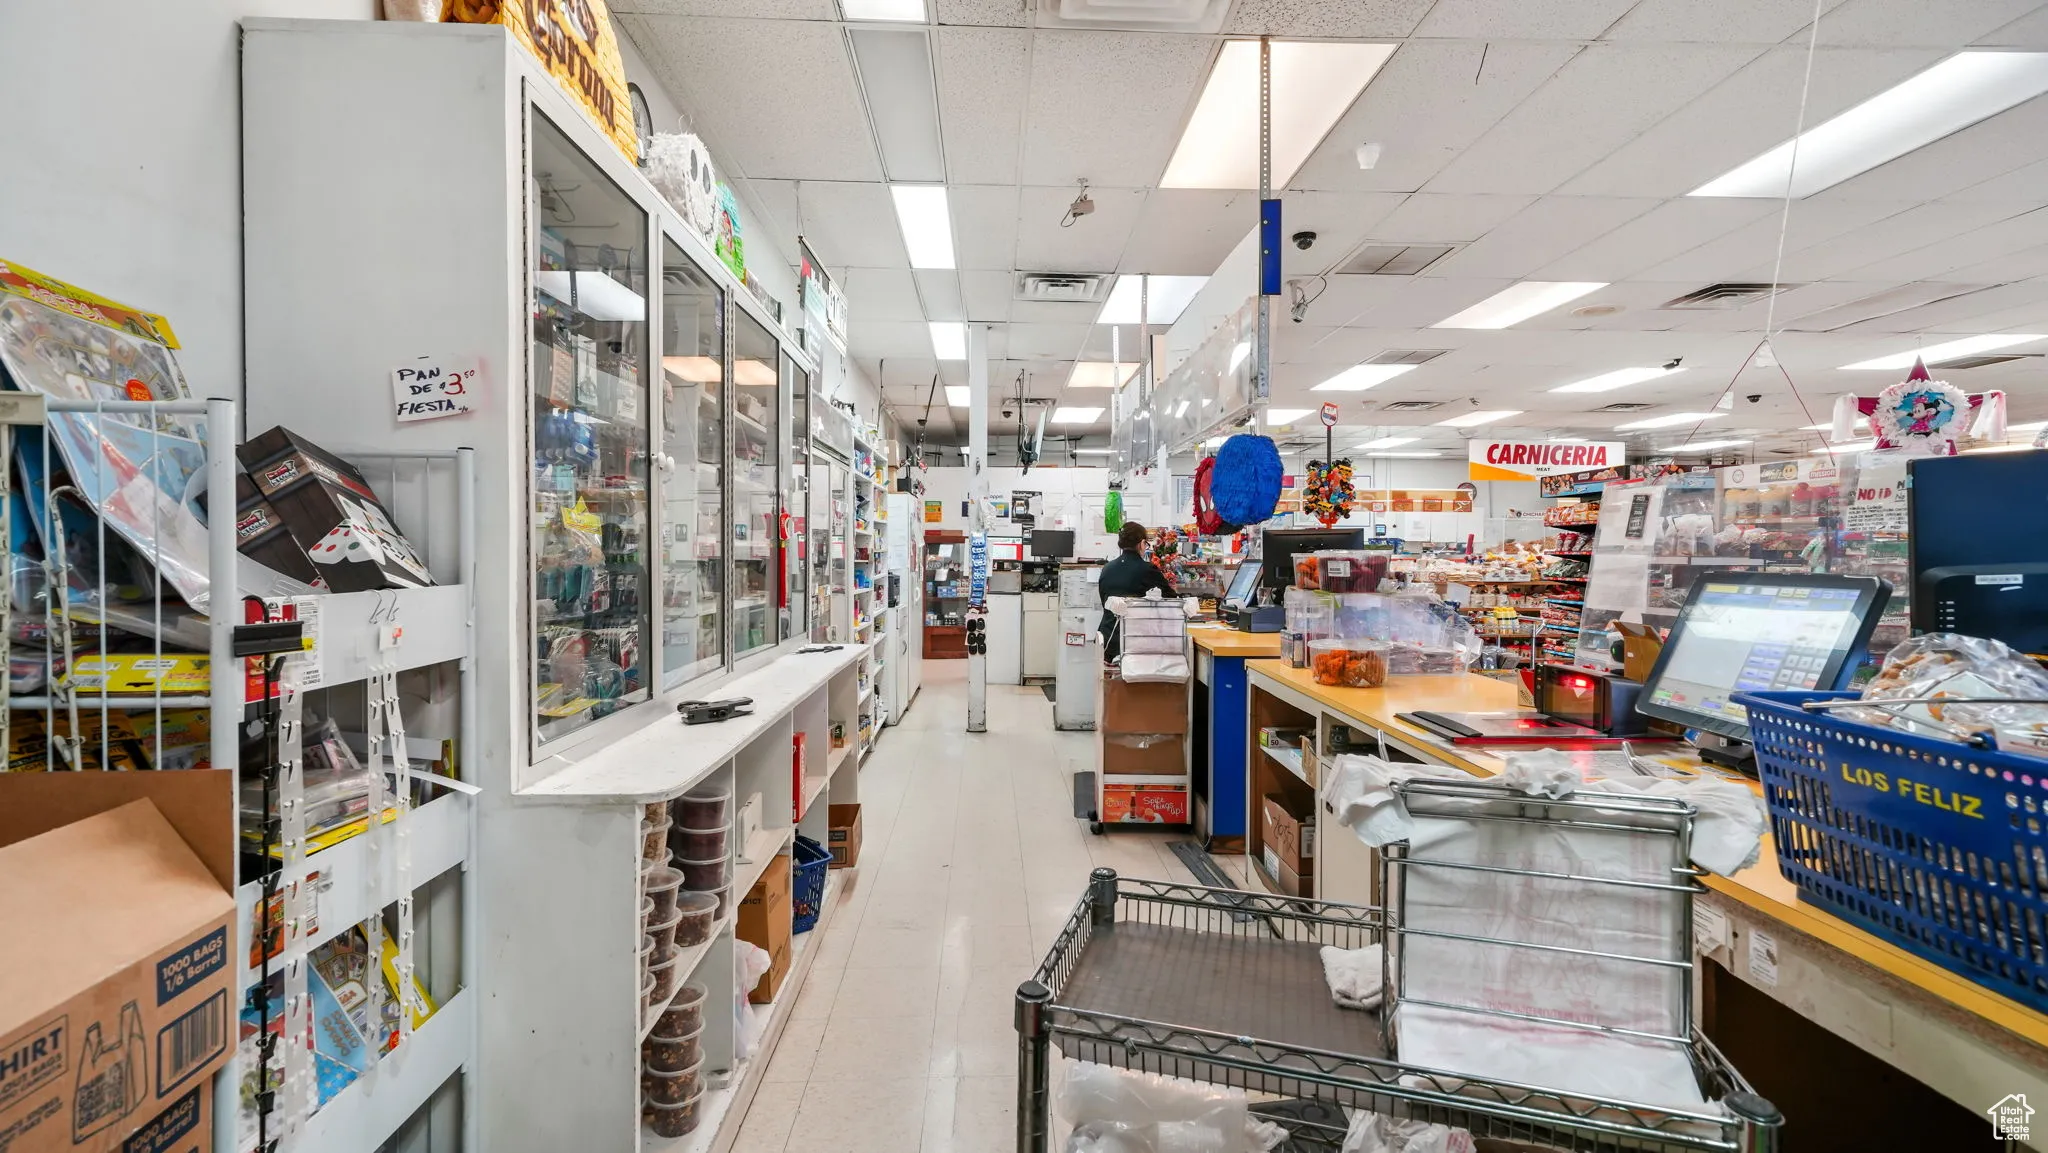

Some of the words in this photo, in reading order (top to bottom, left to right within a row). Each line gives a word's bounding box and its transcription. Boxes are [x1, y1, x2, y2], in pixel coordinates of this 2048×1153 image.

[397, 367, 440, 381] PAN
[409, 383, 433, 395] DE
[397, 399, 456, 415] FIESTA
[1487, 443, 1607, 466] CARNICERIA
[1857, 488, 1876, 500] NO
[1841, 763, 1890, 792] LOS
[1897, 778, 1984, 819] FELIZ
[162, 954, 191, 980] 1000
[193, 935, 223, 962] BAGS
[165, 972, 185, 993] 1/6
[187, 948, 221, 980] Barrel
[163, 1095, 196, 1129] BAGS
